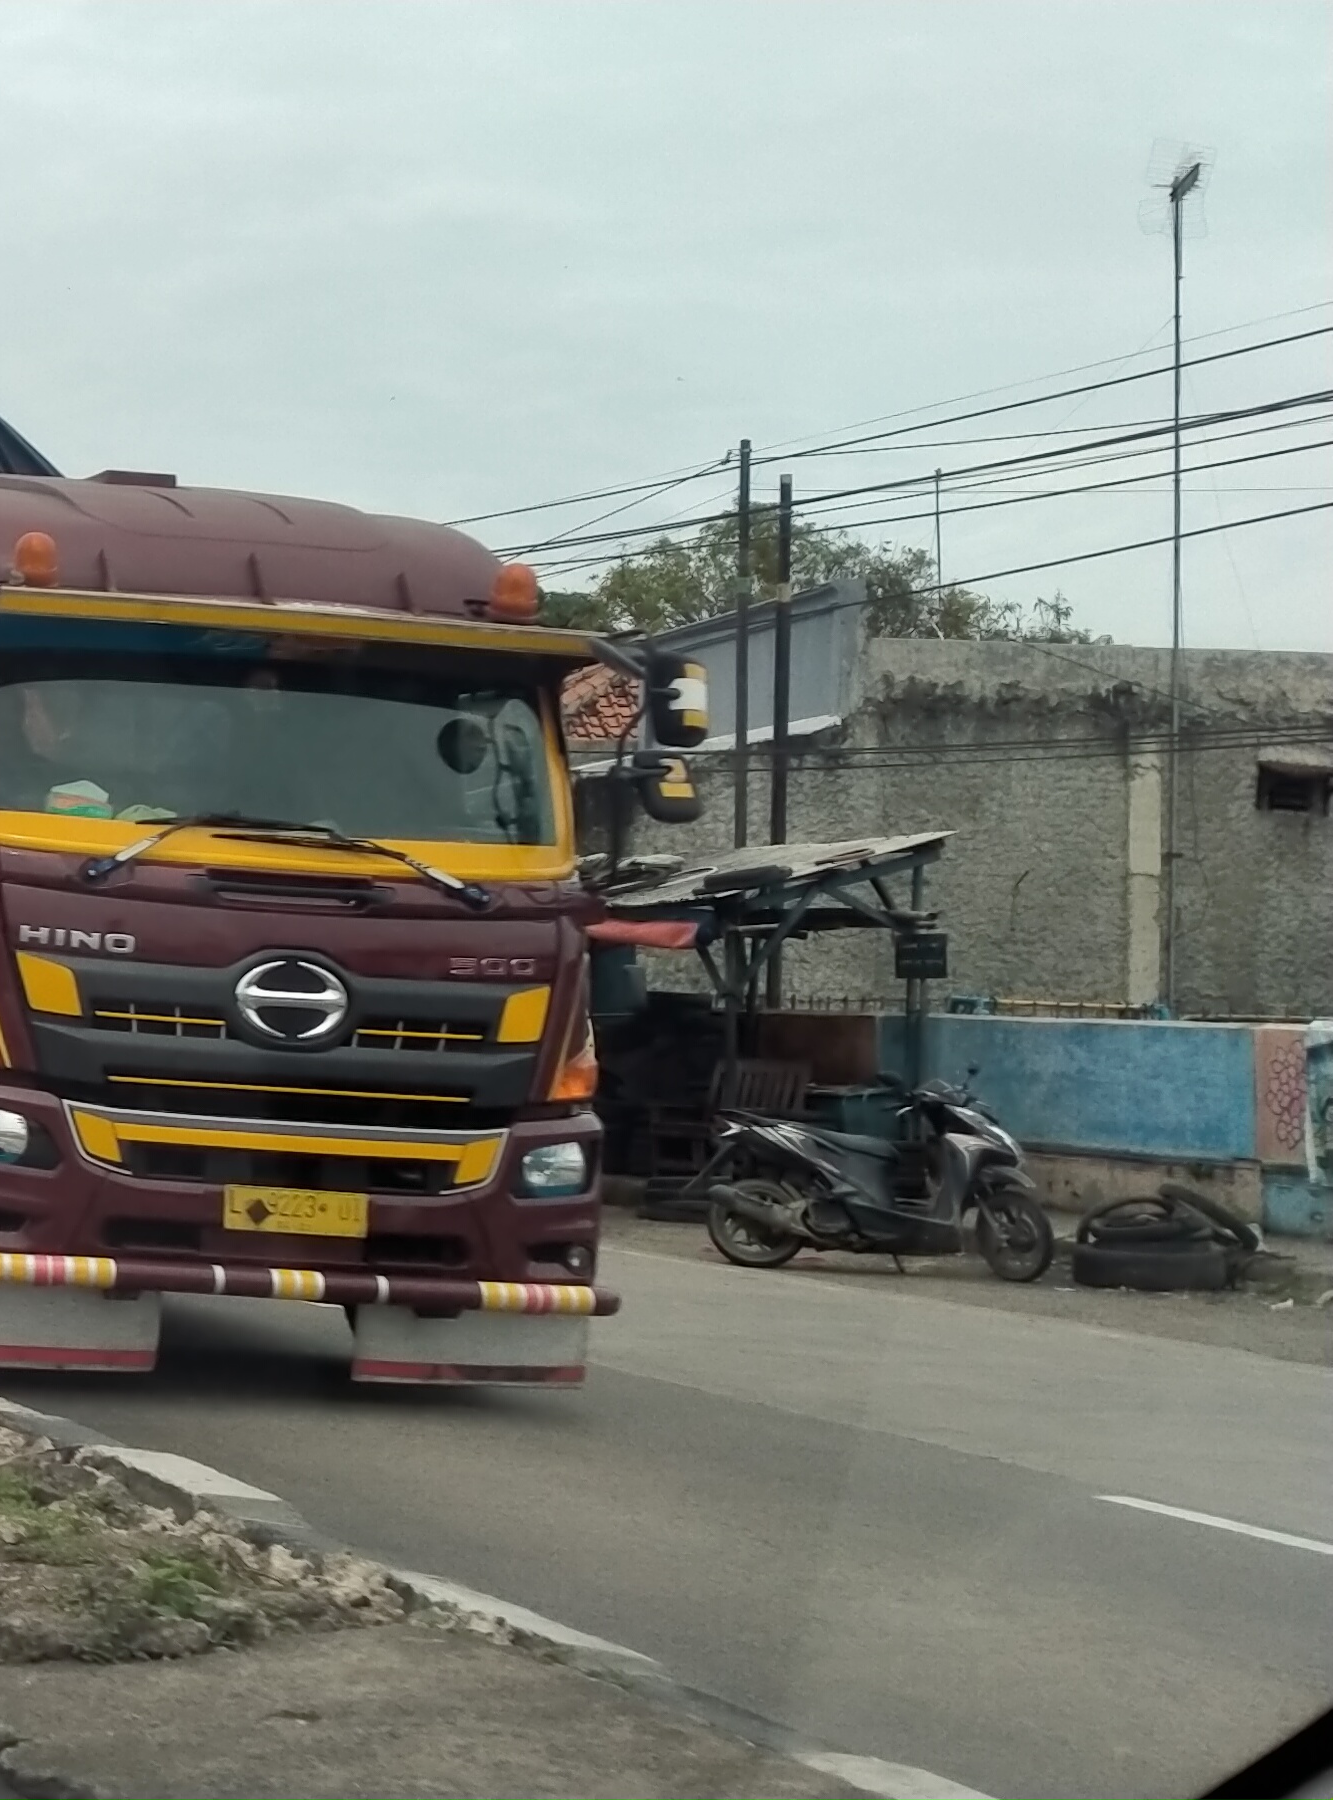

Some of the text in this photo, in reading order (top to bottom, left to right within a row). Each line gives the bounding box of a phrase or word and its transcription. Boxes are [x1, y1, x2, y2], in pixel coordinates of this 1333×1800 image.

[19, 924, 136, 954] HINO
[449, 956, 537, 976] 500
[229, 1189, 242, 1213] L
